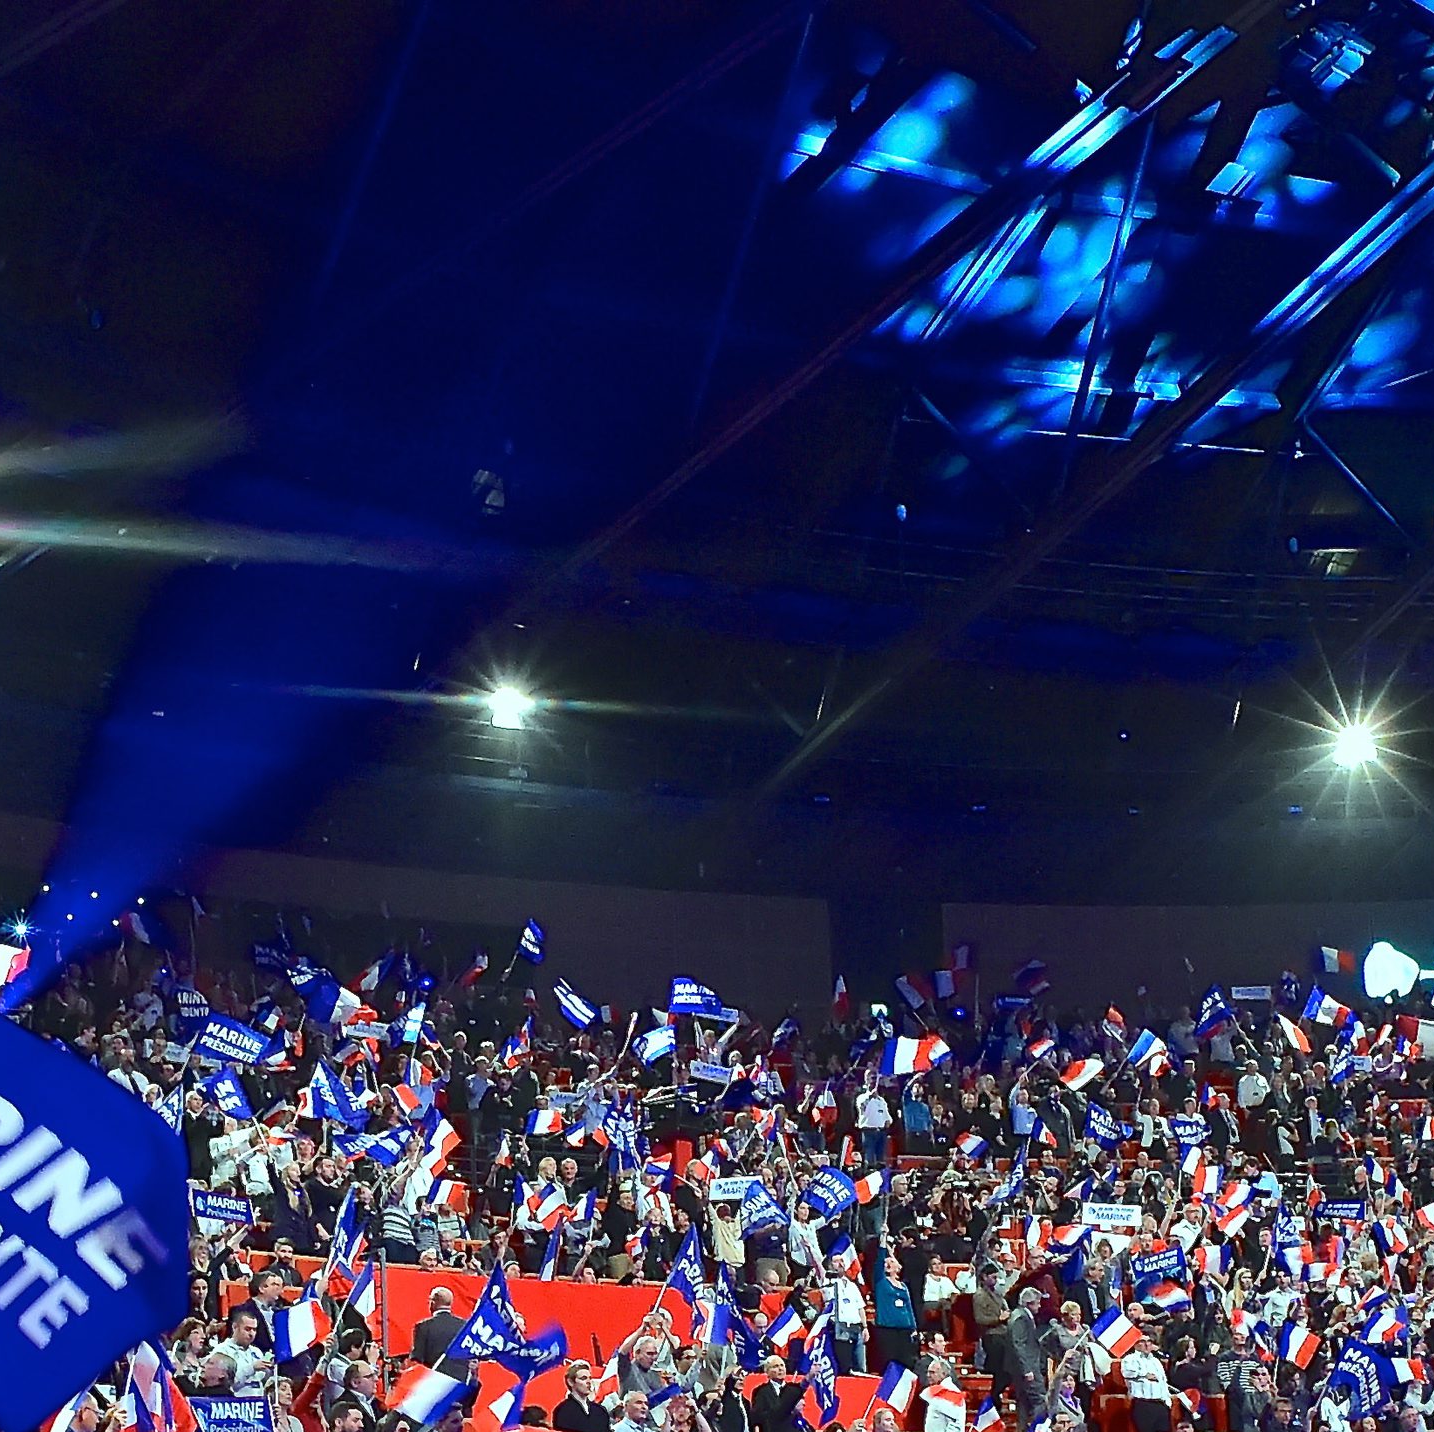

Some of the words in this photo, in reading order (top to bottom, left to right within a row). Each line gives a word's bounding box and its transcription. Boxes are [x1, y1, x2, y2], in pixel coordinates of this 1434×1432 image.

[205, 1021, 263, 1054] MARINE
[200, 1035, 258, 1064] PRÉSIDENTE
[207, 1195, 248, 1212] MARINE
[210, 1402, 265, 1420] MARINE
